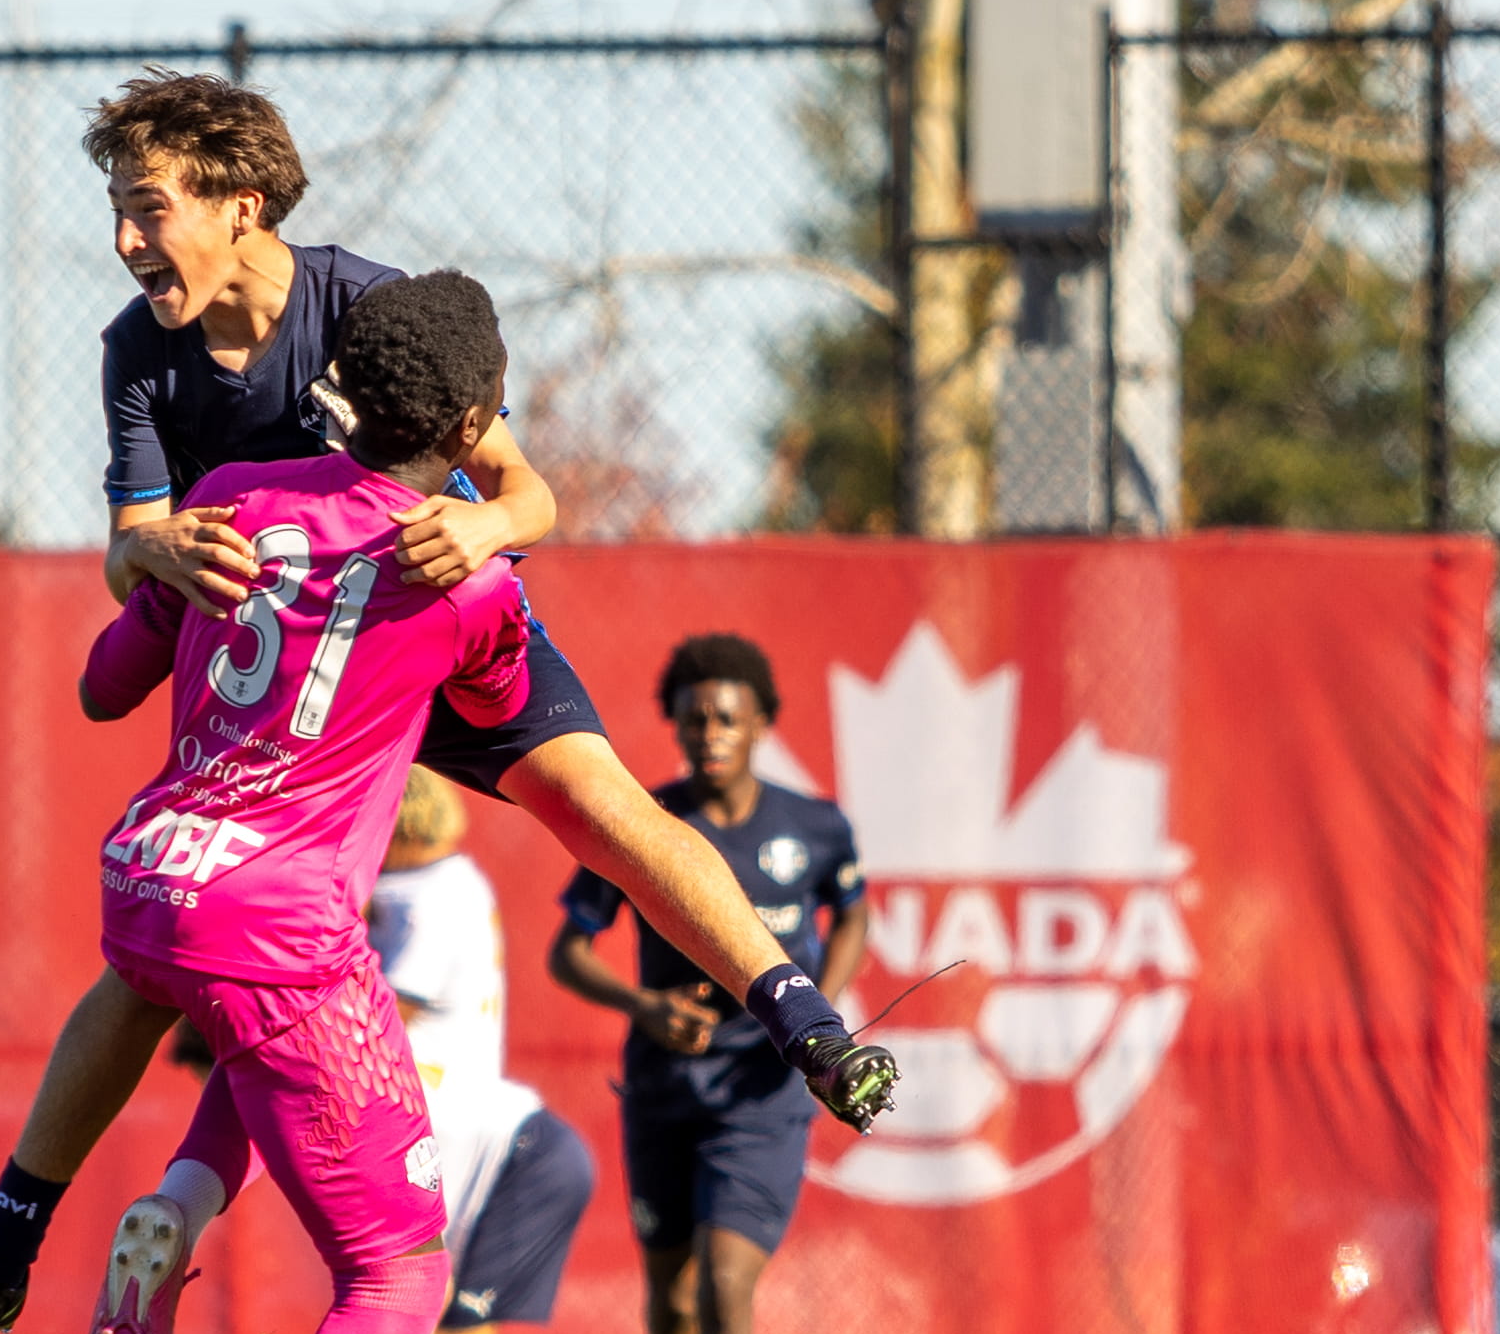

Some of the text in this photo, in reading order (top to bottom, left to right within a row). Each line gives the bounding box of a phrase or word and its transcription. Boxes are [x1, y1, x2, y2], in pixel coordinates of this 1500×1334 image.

[208, 524, 379, 740] 31
[101, 867, 199, 909] ssurances
[866, 885, 1198, 980] NADA
